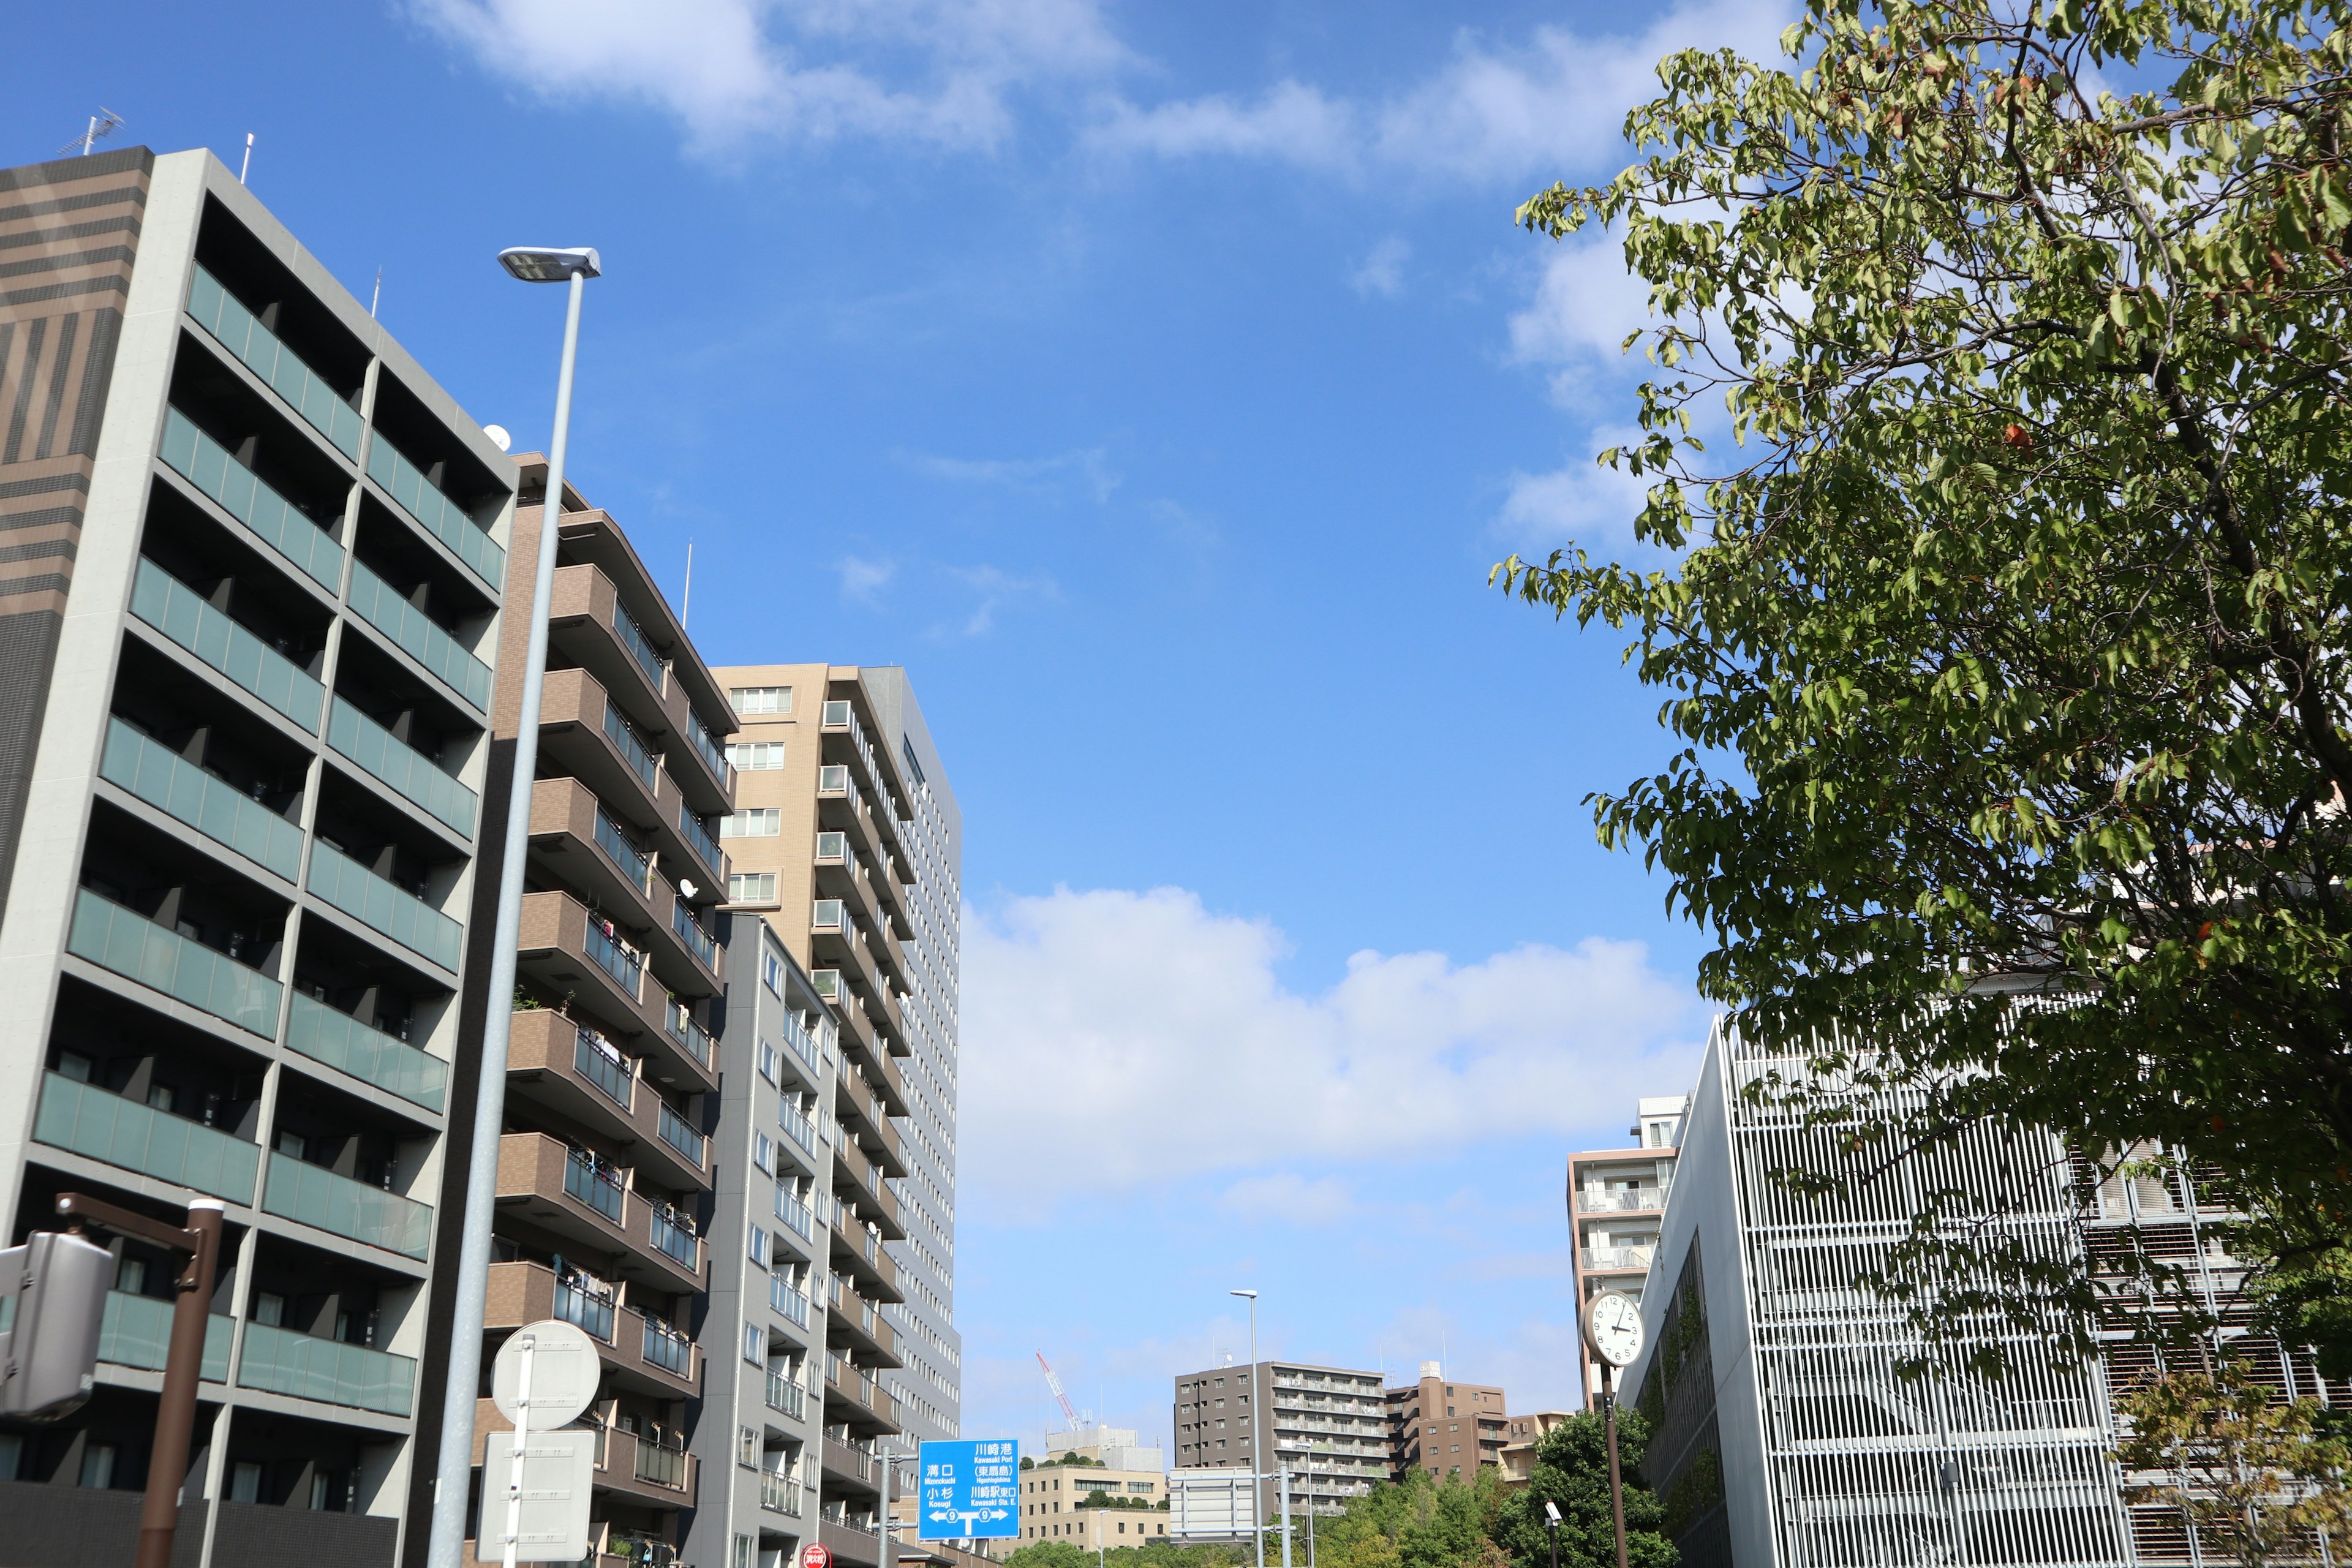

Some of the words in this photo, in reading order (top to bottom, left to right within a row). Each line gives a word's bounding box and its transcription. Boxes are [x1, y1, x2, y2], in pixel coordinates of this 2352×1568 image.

[975, 1443, 1012, 1456] 川崎港
[926, 1464, 953, 1477] 溝口
[926, 1487, 954, 1500] 小杉
[971, 1485, 1016, 1499] 川崎駅東口
[949, 1511, 956, 1521] 9
[981, 1510, 988, 1520] 9
